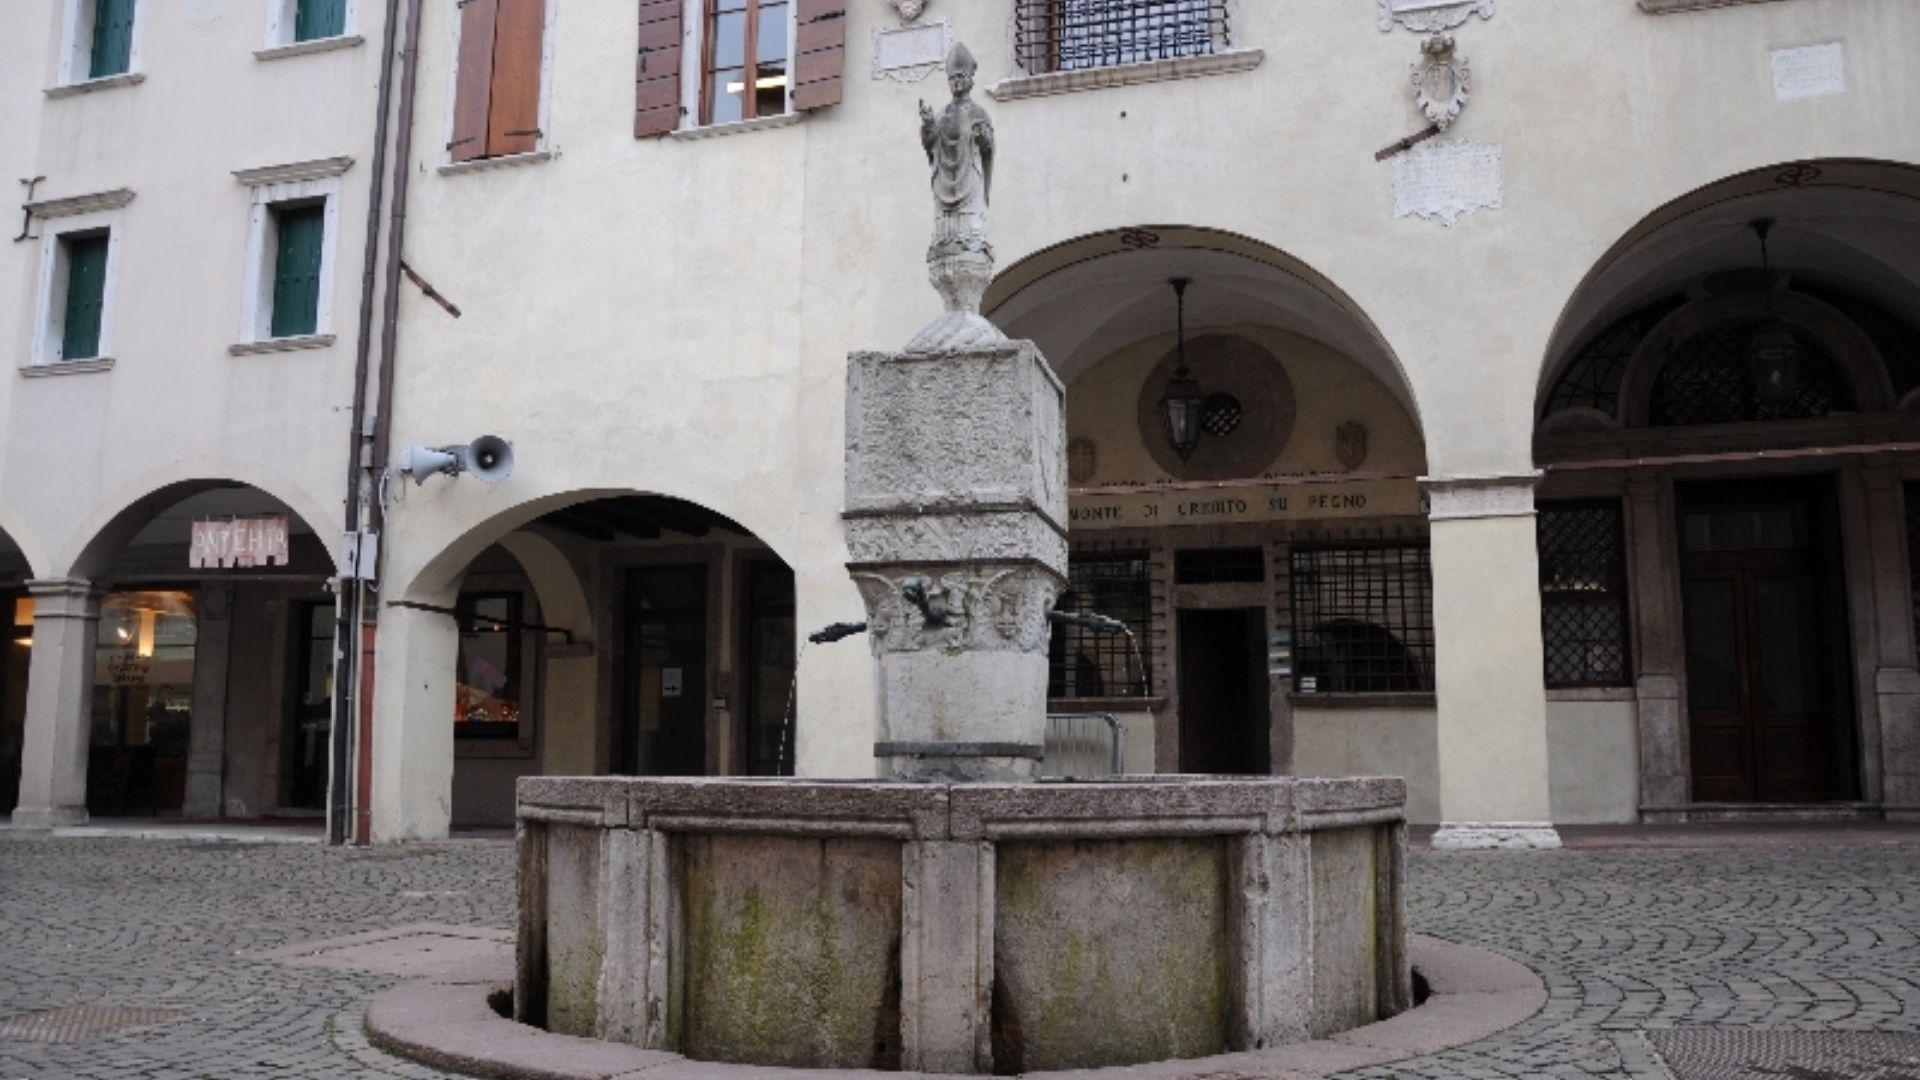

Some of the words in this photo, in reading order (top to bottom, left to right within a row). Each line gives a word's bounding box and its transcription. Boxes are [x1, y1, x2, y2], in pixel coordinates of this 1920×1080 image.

[1142, 504, 1158, 518] DI
[1268, 496, 1288, 511] SU
[1308, 494, 1367, 509] PEGNO
